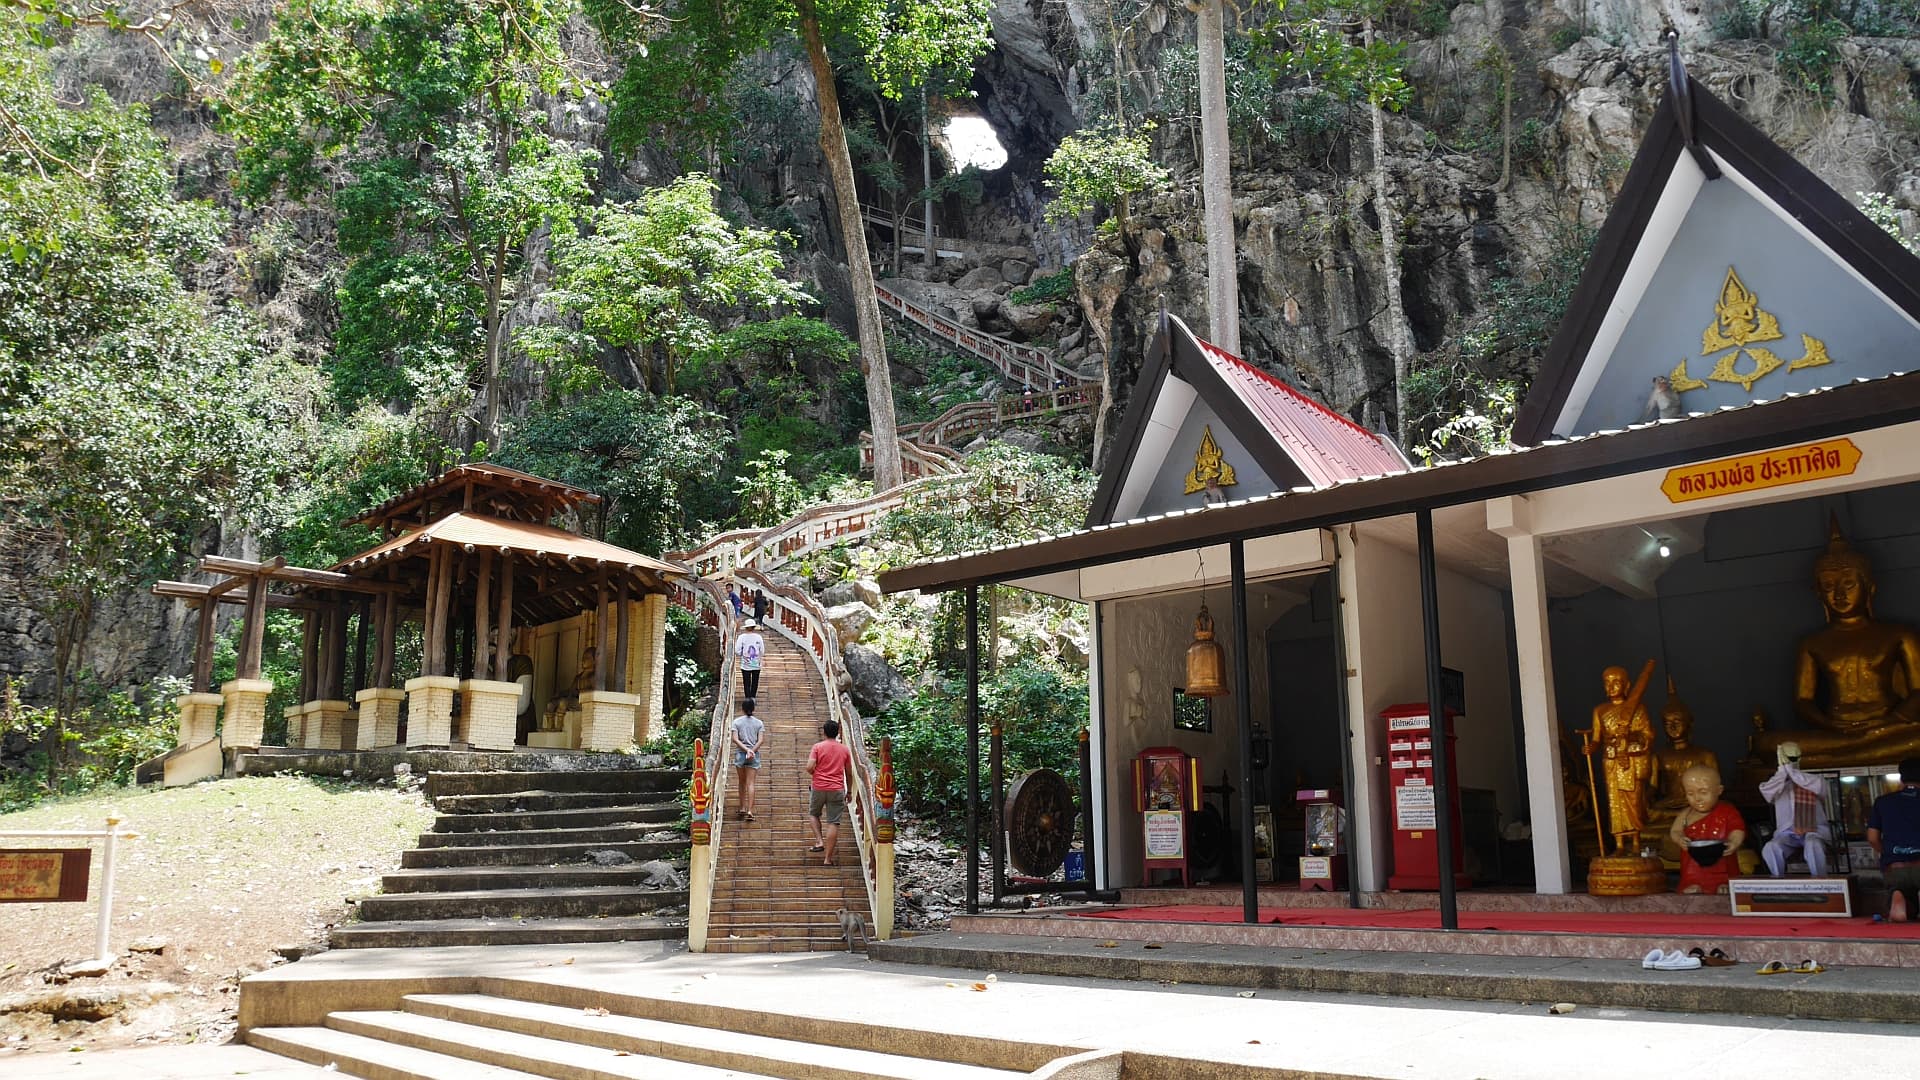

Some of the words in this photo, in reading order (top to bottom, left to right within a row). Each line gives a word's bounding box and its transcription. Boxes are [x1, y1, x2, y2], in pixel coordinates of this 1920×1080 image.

[1678, 463, 1755, 495] หลวงพ่อ
[1760, 446, 1841, 480] ประกาศิต
